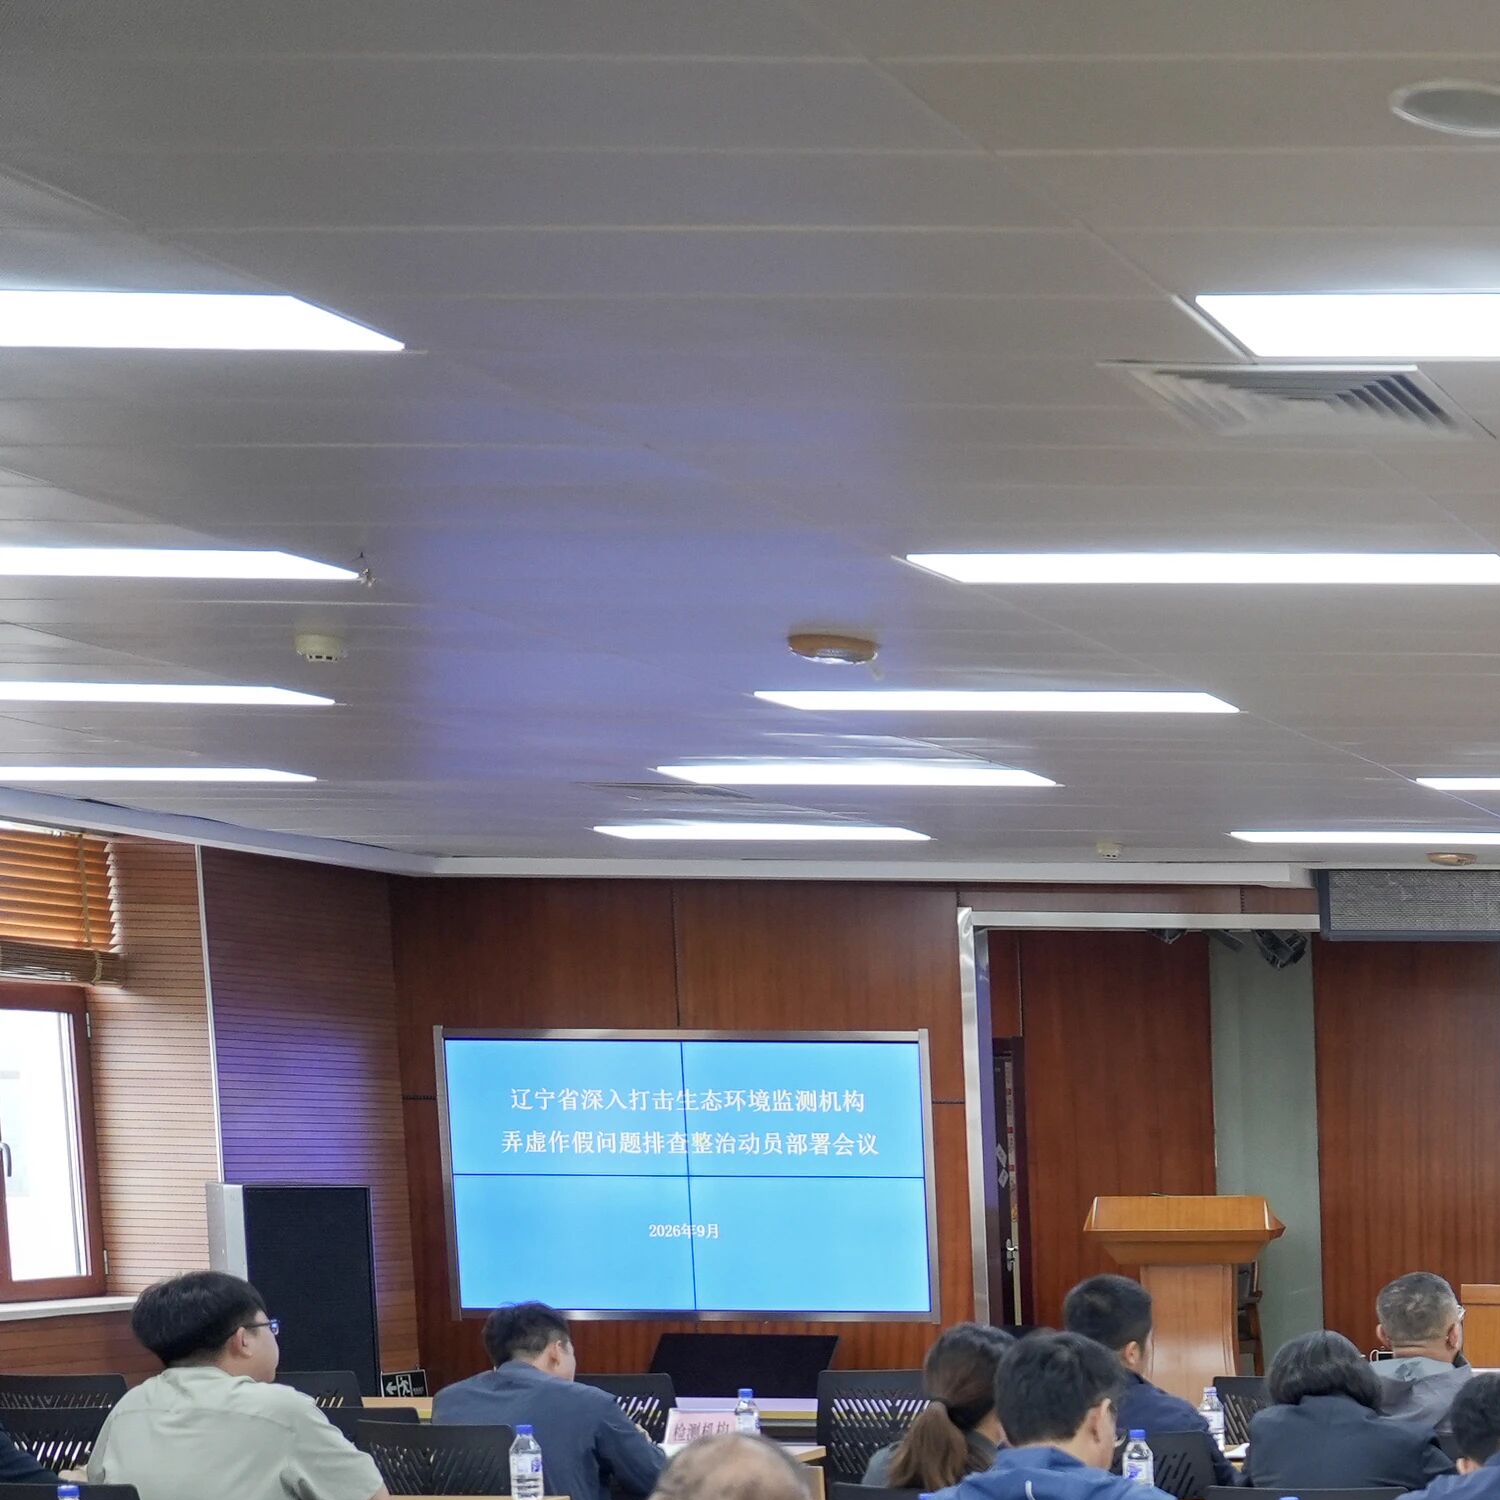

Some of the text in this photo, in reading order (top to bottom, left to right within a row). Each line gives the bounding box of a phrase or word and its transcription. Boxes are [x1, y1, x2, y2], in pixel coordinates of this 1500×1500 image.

[510, 1087, 865, 1114] 辽宁省深入打击生态环境监测机构
[501, 1129, 879, 1156] 弄虚作假问题排查整治动员部署会议
[648, 1223, 720, 1239] 2026年9月
